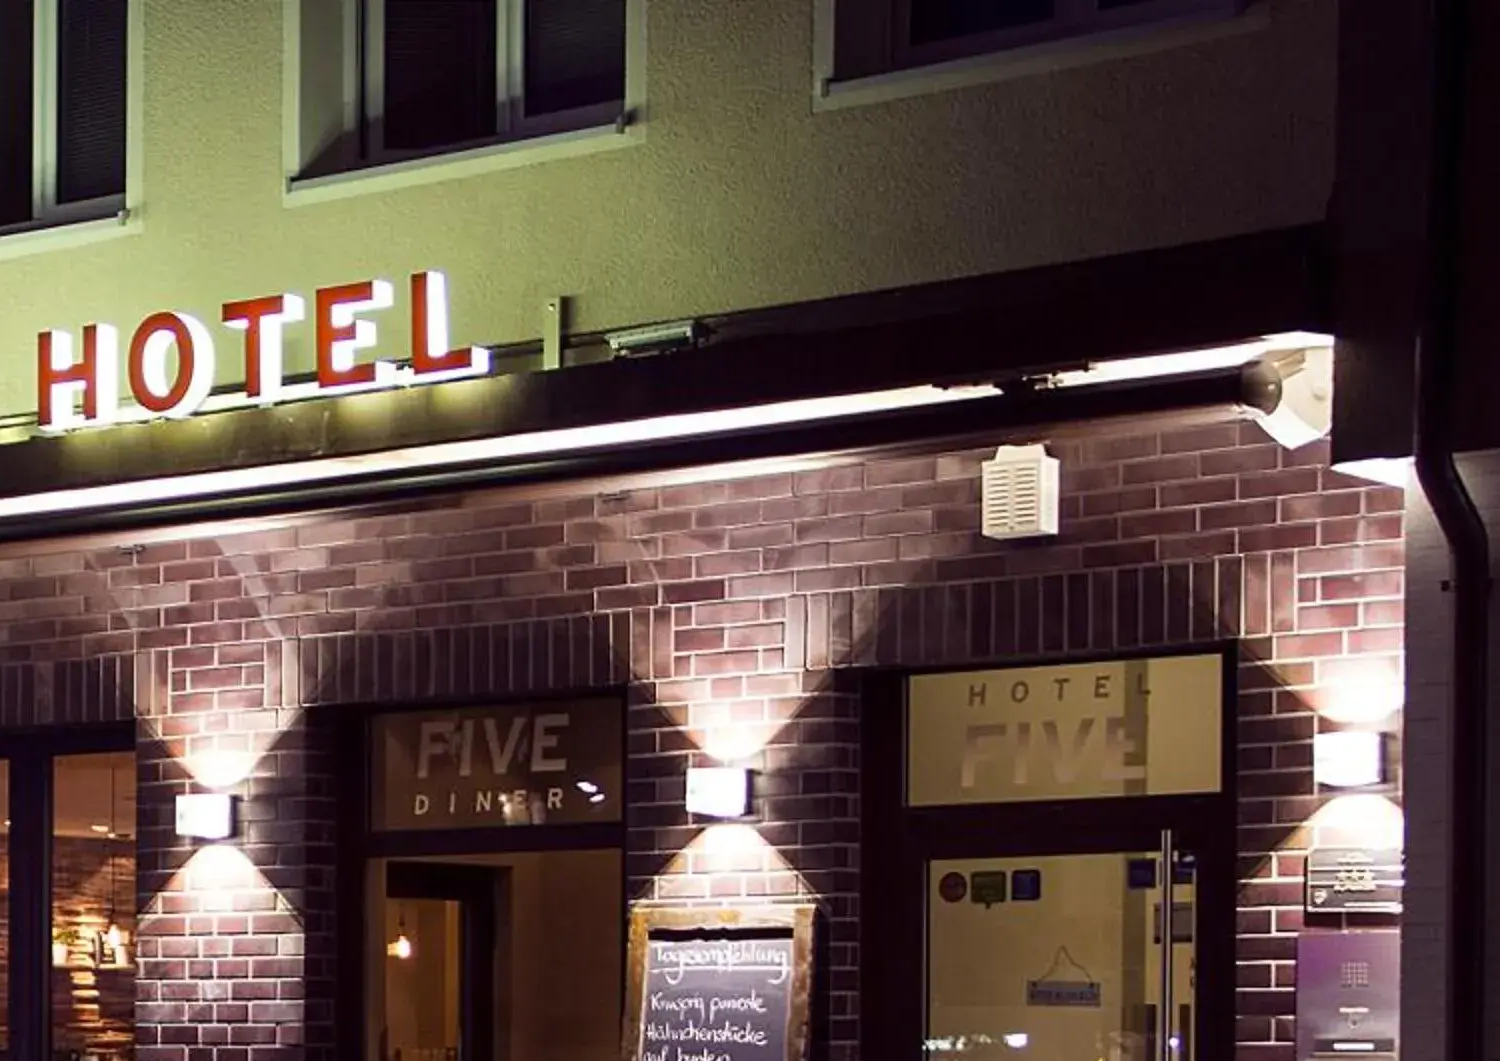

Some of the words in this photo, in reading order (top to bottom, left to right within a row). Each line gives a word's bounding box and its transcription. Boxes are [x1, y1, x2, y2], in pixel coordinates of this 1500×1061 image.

[38, 270, 490, 435] HOTEL
[968, 675, 1152, 706] HOTEL
[417, 713, 570, 779] FIVE
[961, 716, 1147, 788] FIVE
[414, 788, 564, 815] DINER
